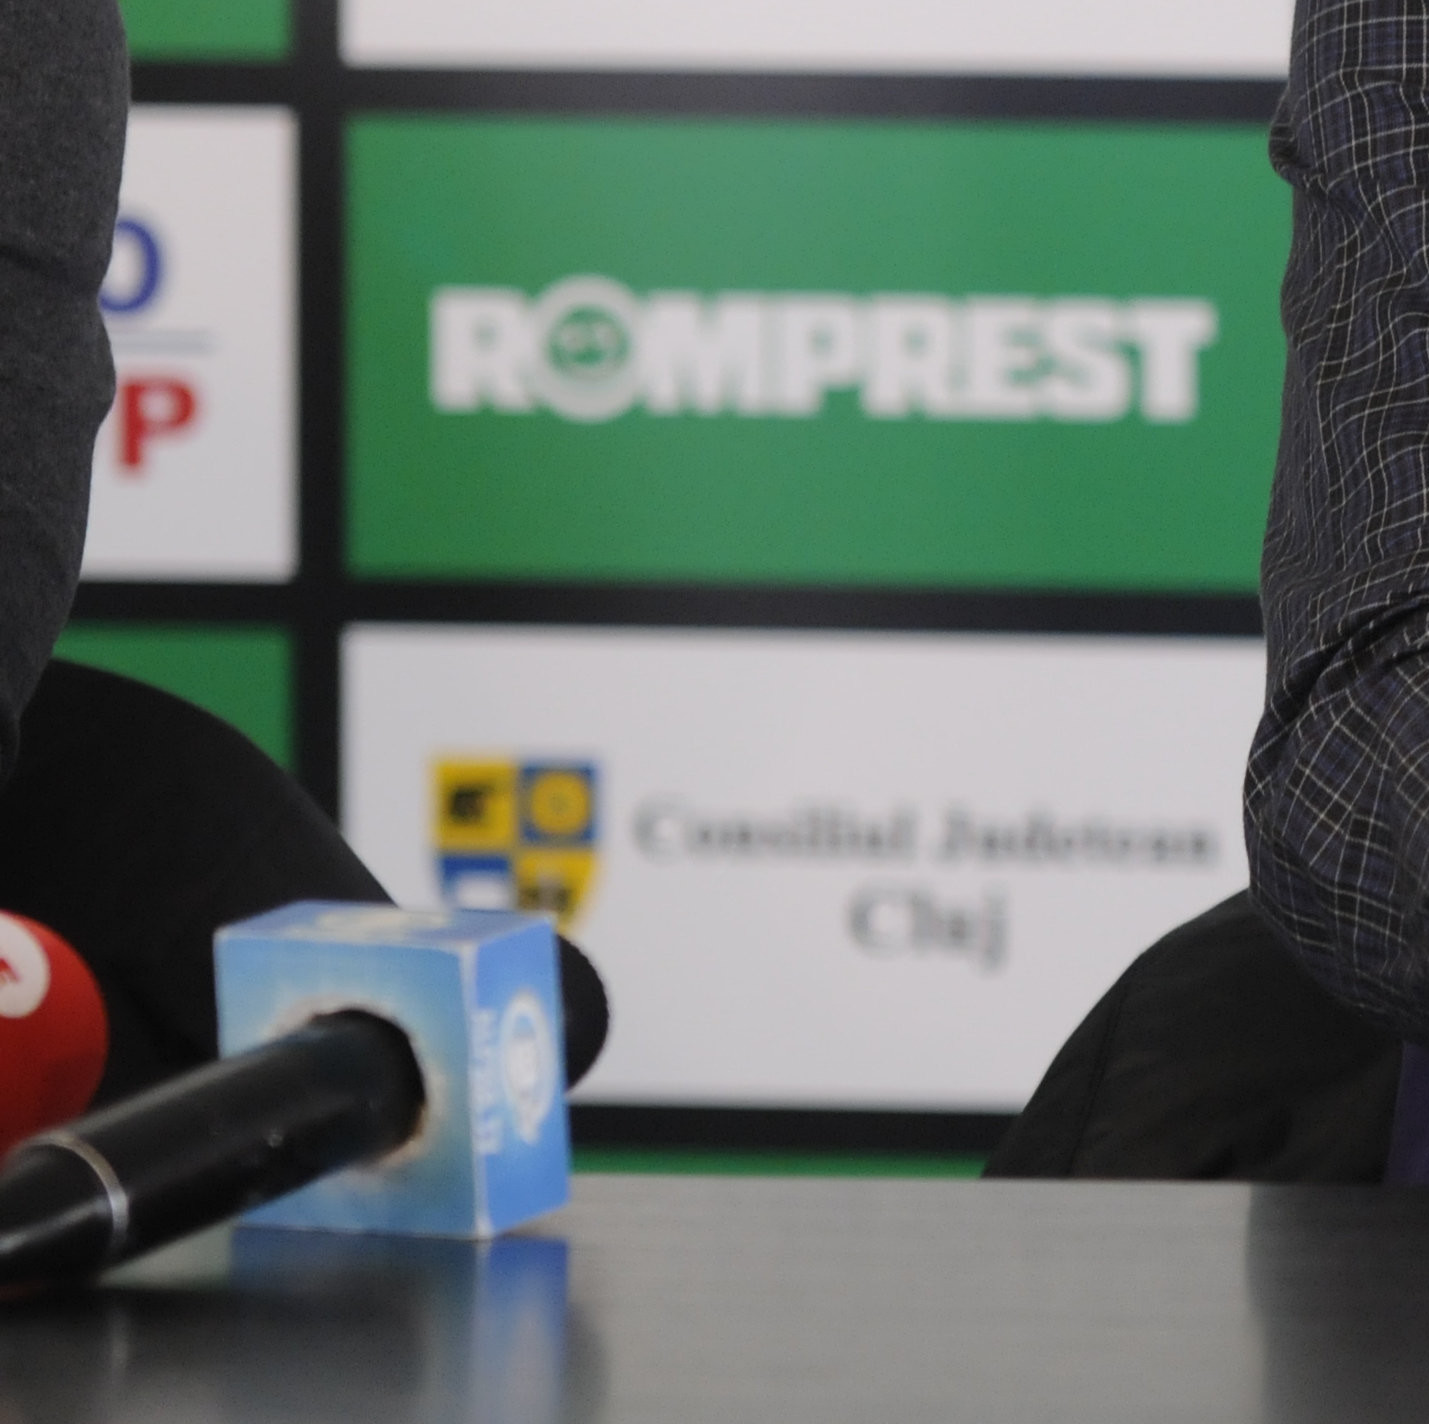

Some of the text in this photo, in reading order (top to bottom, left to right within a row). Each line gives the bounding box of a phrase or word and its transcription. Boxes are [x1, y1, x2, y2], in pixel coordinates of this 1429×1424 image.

[430, 274, 1217, 424] ROMPREST
[632, 793, 1220, 869] Consiliul Judetean
[847, 880, 1009, 978] Cluj
